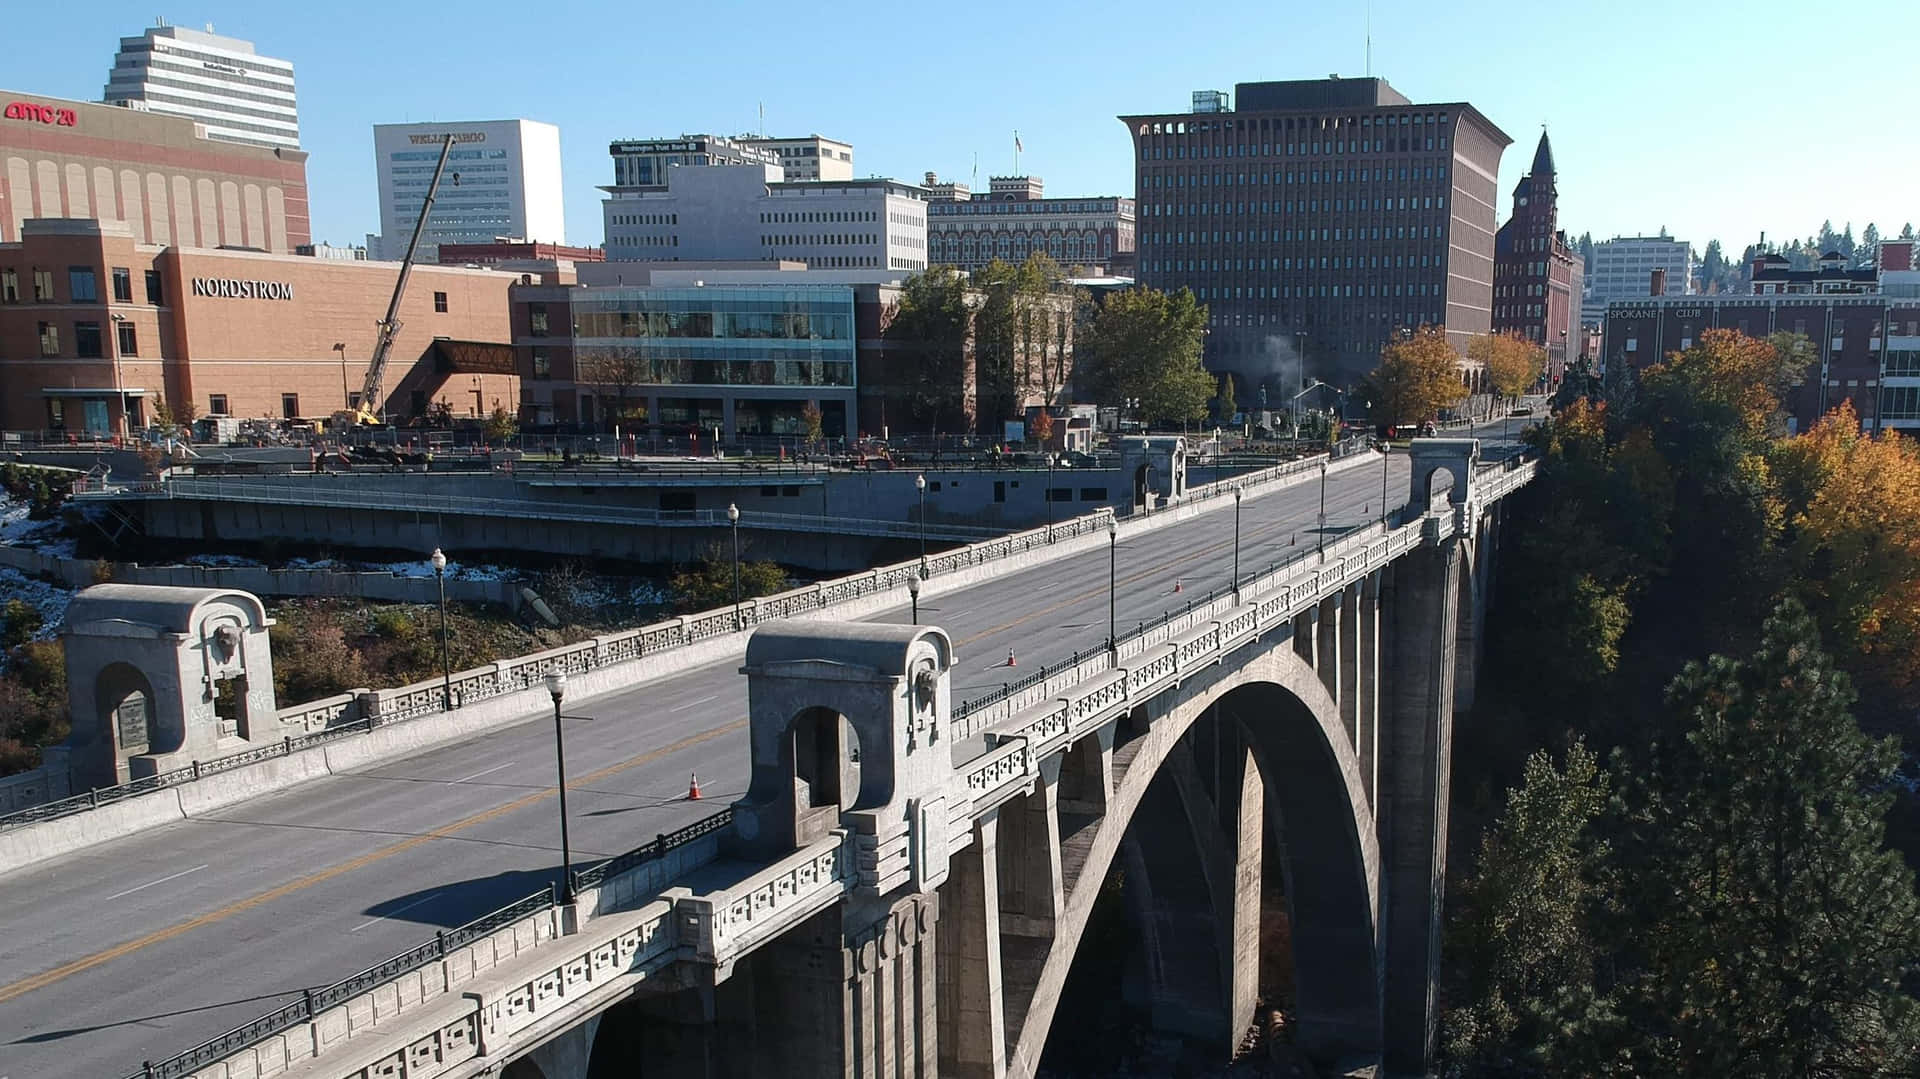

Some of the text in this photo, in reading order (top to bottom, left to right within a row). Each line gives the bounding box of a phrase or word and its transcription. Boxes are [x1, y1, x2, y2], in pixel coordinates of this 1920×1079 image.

[57, 109, 77, 127] 20
[192, 277, 293, 300] NORDSTROM
[1610, 309, 1701, 319] SPOKANE CLUB
